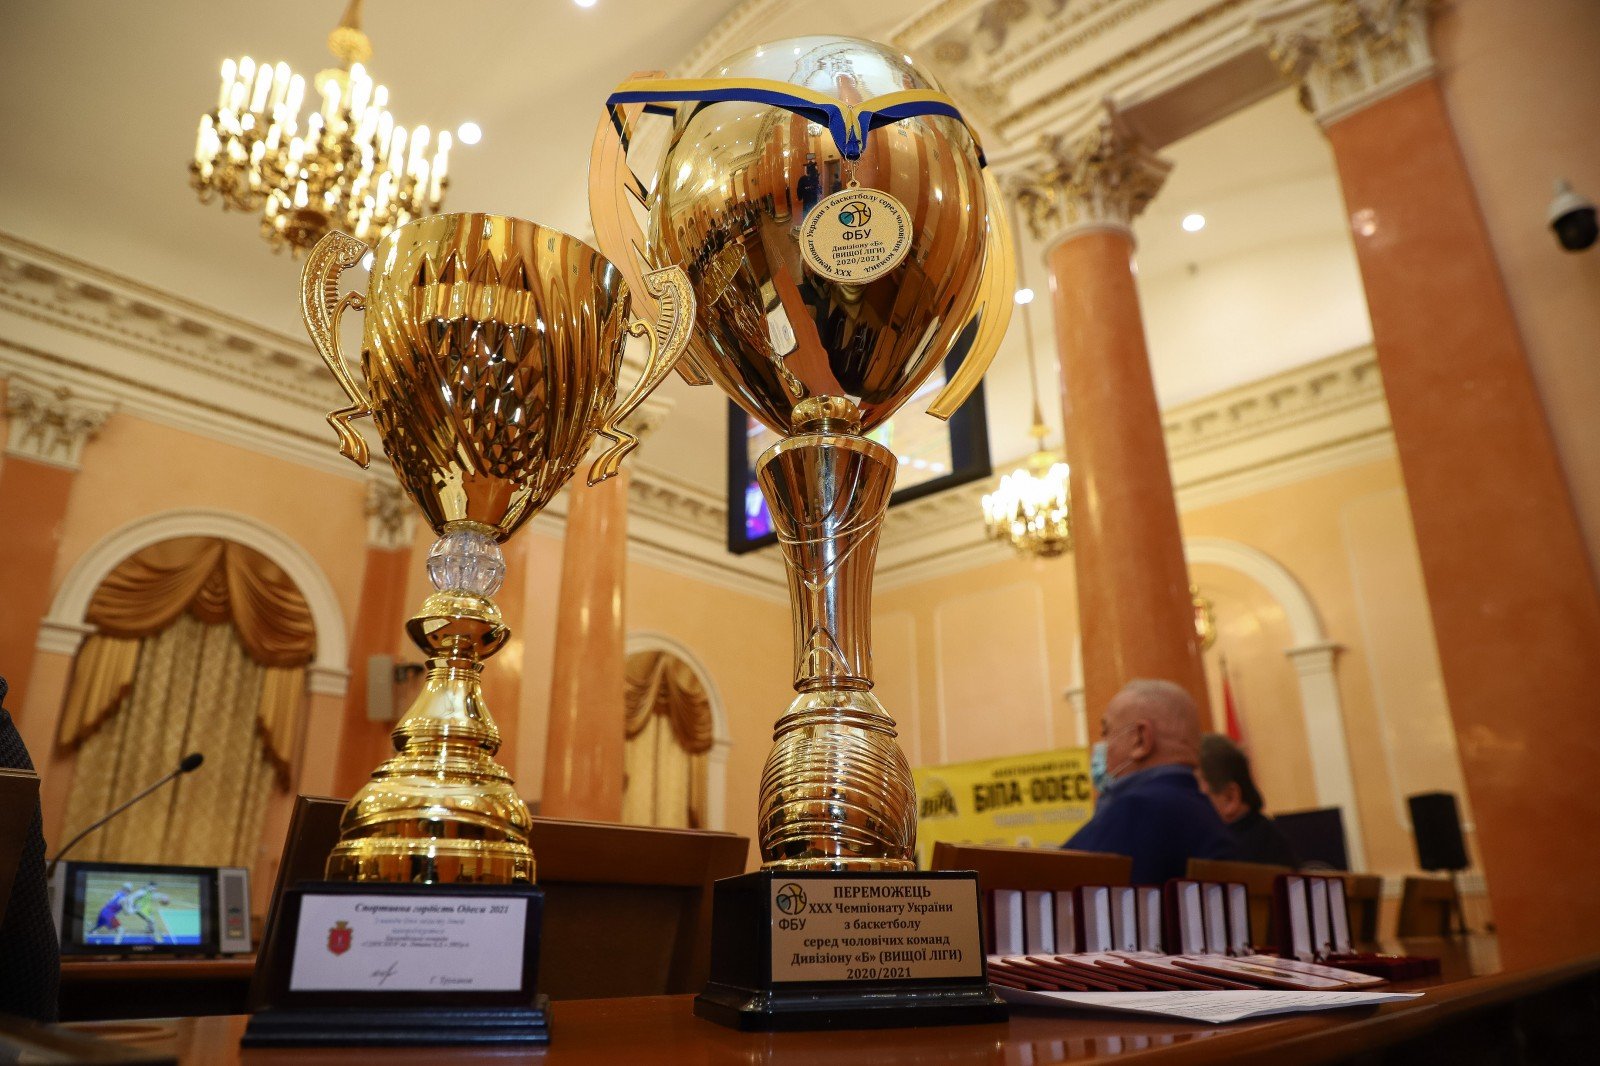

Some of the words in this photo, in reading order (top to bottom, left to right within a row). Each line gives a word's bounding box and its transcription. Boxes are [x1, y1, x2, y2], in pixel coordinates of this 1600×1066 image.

[830, 192, 878, 207] баскетболу
[879, 198, 898, 215] серед
[806, 209, 826, 238] України
[842, 228, 872, 241] ФБУ
[892, 214, 906, 254] чоловічих
[831, 242, 869, 253] Дивізіону
[832, 249, 863, 260] (ВИЩОЇ
[863, 246, 886, 255] ЛІГИ)
[808, 239, 833, 273] Чемпіонат
[836, 255, 881, 266] 2020/2021
[972, 772, 1091, 813] БІПА-ОДЕС
[833, 886, 932, 900] ПЕРЕМОЖЕЦЬ
[456, 905, 487, 915] Одеси
[489, 905, 510, 914] 2021
[835, 903, 905, 917] Чемпіонату
[907, 902, 953, 914] України
[778, 918, 807, 931] ФБУ
[844, 921, 851, 930] з
[853, 918, 921, 931] баскетболу
[803, 936, 839, 949] серед
[841, 934, 904, 946] чоловічих
[906, 935, 950, 946] команд
[791, 952, 853, 967] Дивізіону
[855, 953, 876, 963] «Б»
[879, 950, 927, 965] (ВИЩОЇ
[930, 949, 963, 962] ЛІГИ)
[846, 967, 912, 980] 2020/2021
